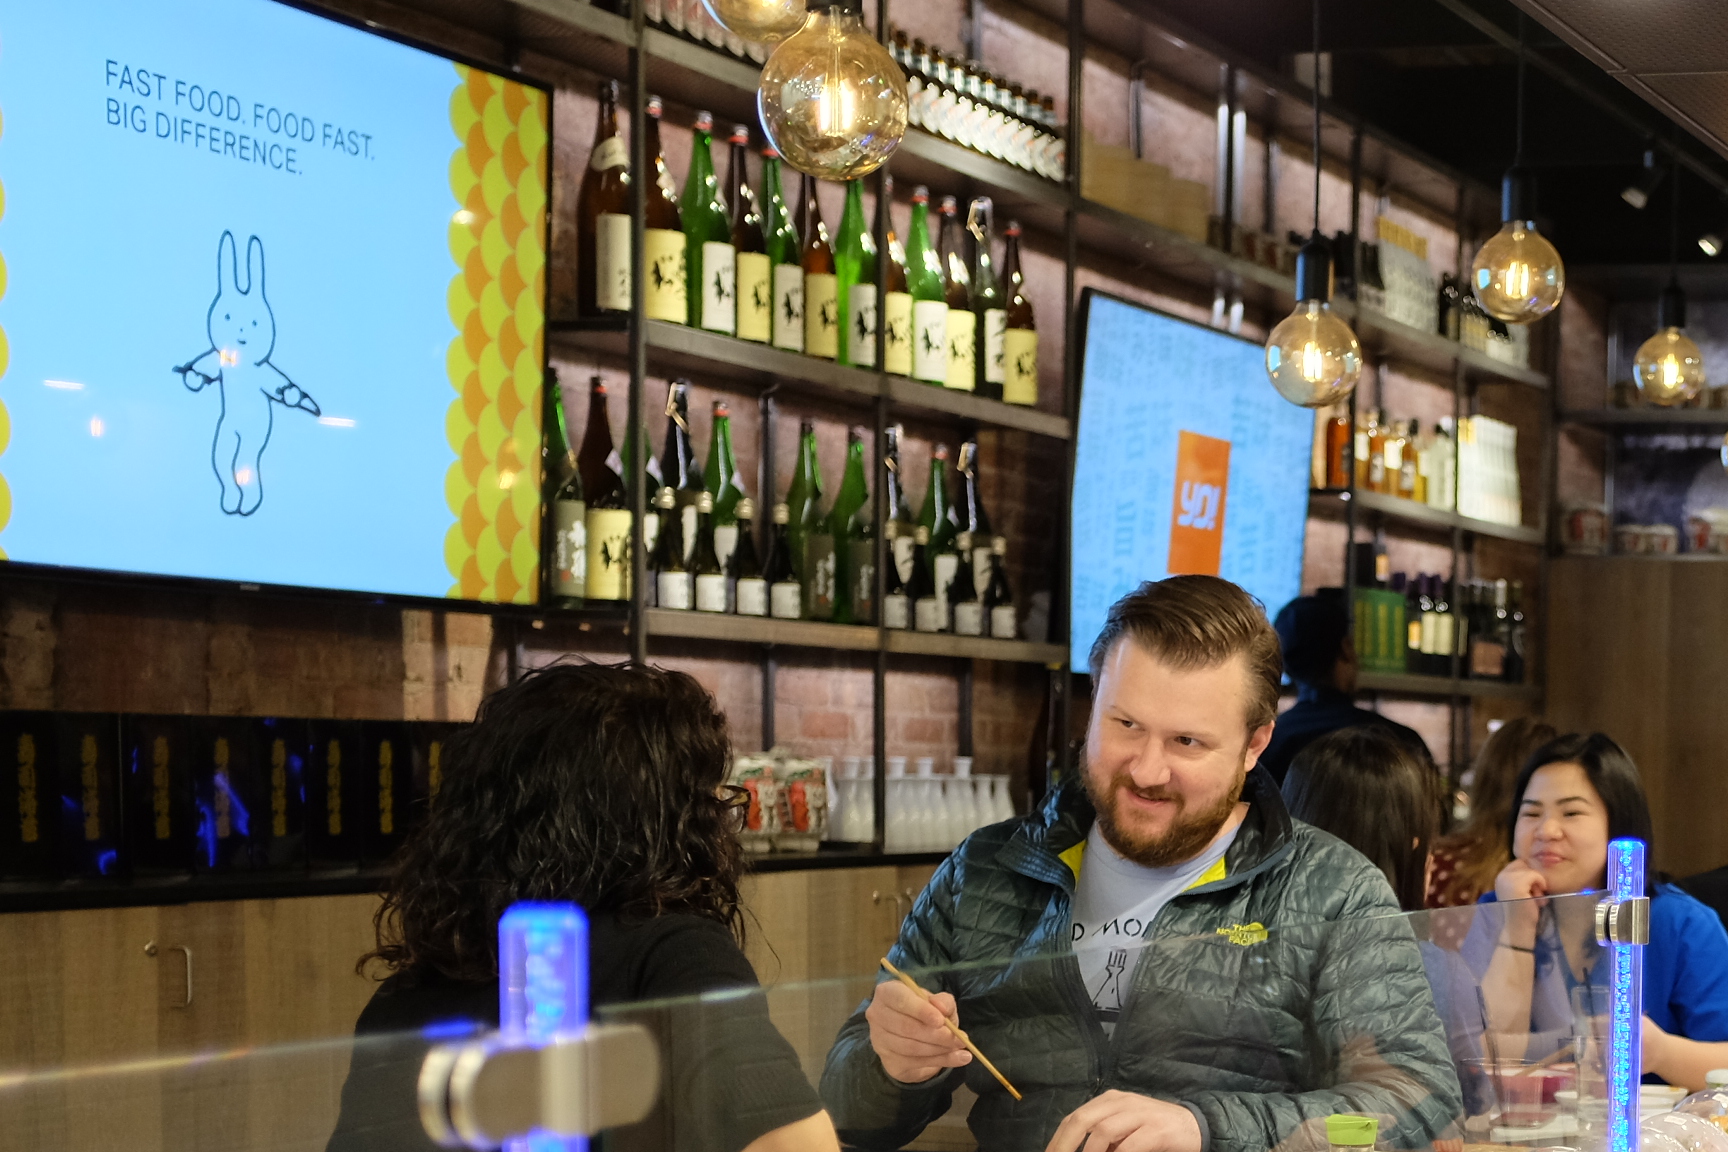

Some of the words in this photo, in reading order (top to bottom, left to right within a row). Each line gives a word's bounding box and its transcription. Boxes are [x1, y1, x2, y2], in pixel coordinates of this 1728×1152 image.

[105, 59, 167, 101] FAST
[175, 79, 246, 125] FOOD.
[253, 102, 315, 143] FOOD
[321, 122, 375, 161] FAST.
[106, 97, 147, 134] BIG
[155, 111, 303, 176] DIFFERENCE.
[1232, 923, 1250, 932] THE
